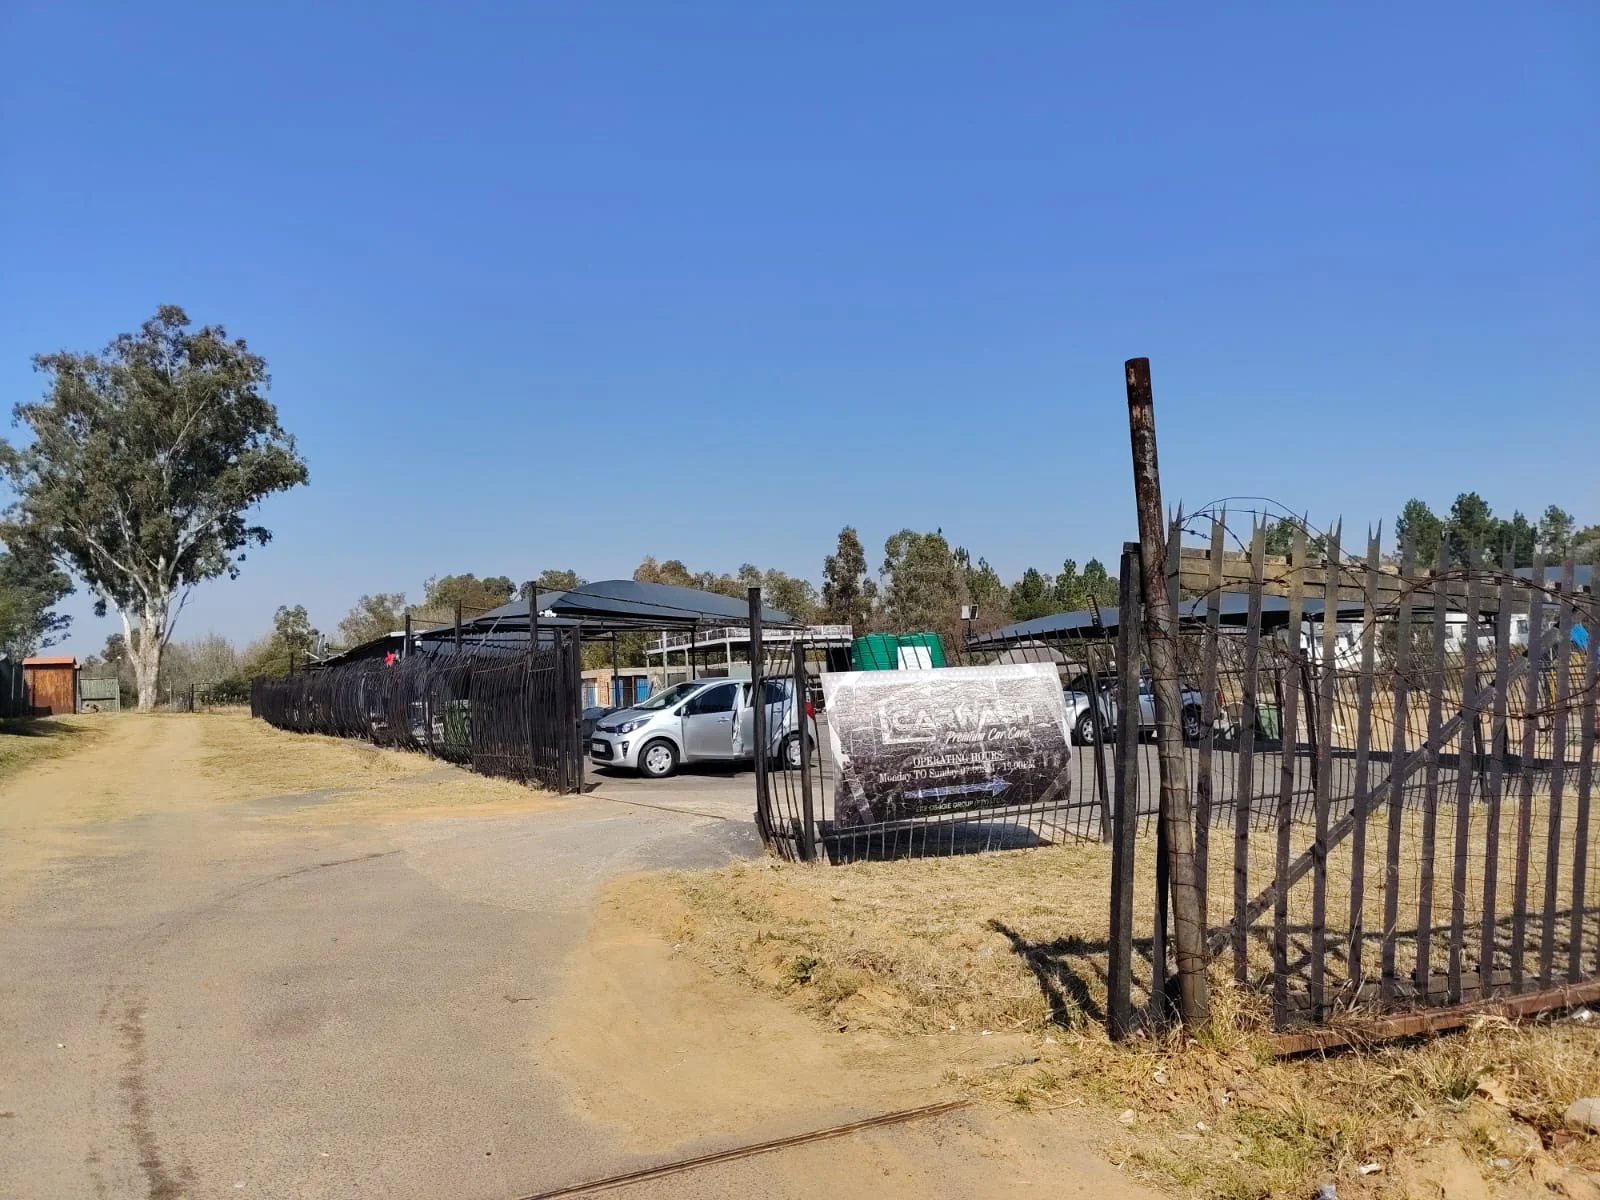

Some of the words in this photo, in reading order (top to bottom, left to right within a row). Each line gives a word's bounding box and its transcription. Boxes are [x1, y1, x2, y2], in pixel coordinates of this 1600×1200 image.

[945, 730, 985, 745] Premium
[987, 727, 1006, 742] Car
[913, 753, 968, 768] OPERATING
[970, 749, 1003, 763] HOURS
[879, 771, 911, 783] Monday
[914, 769, 926, 780] TO
[928, 767, 957, 780] Sunday
[953, 800, 973, 809] GROUP
